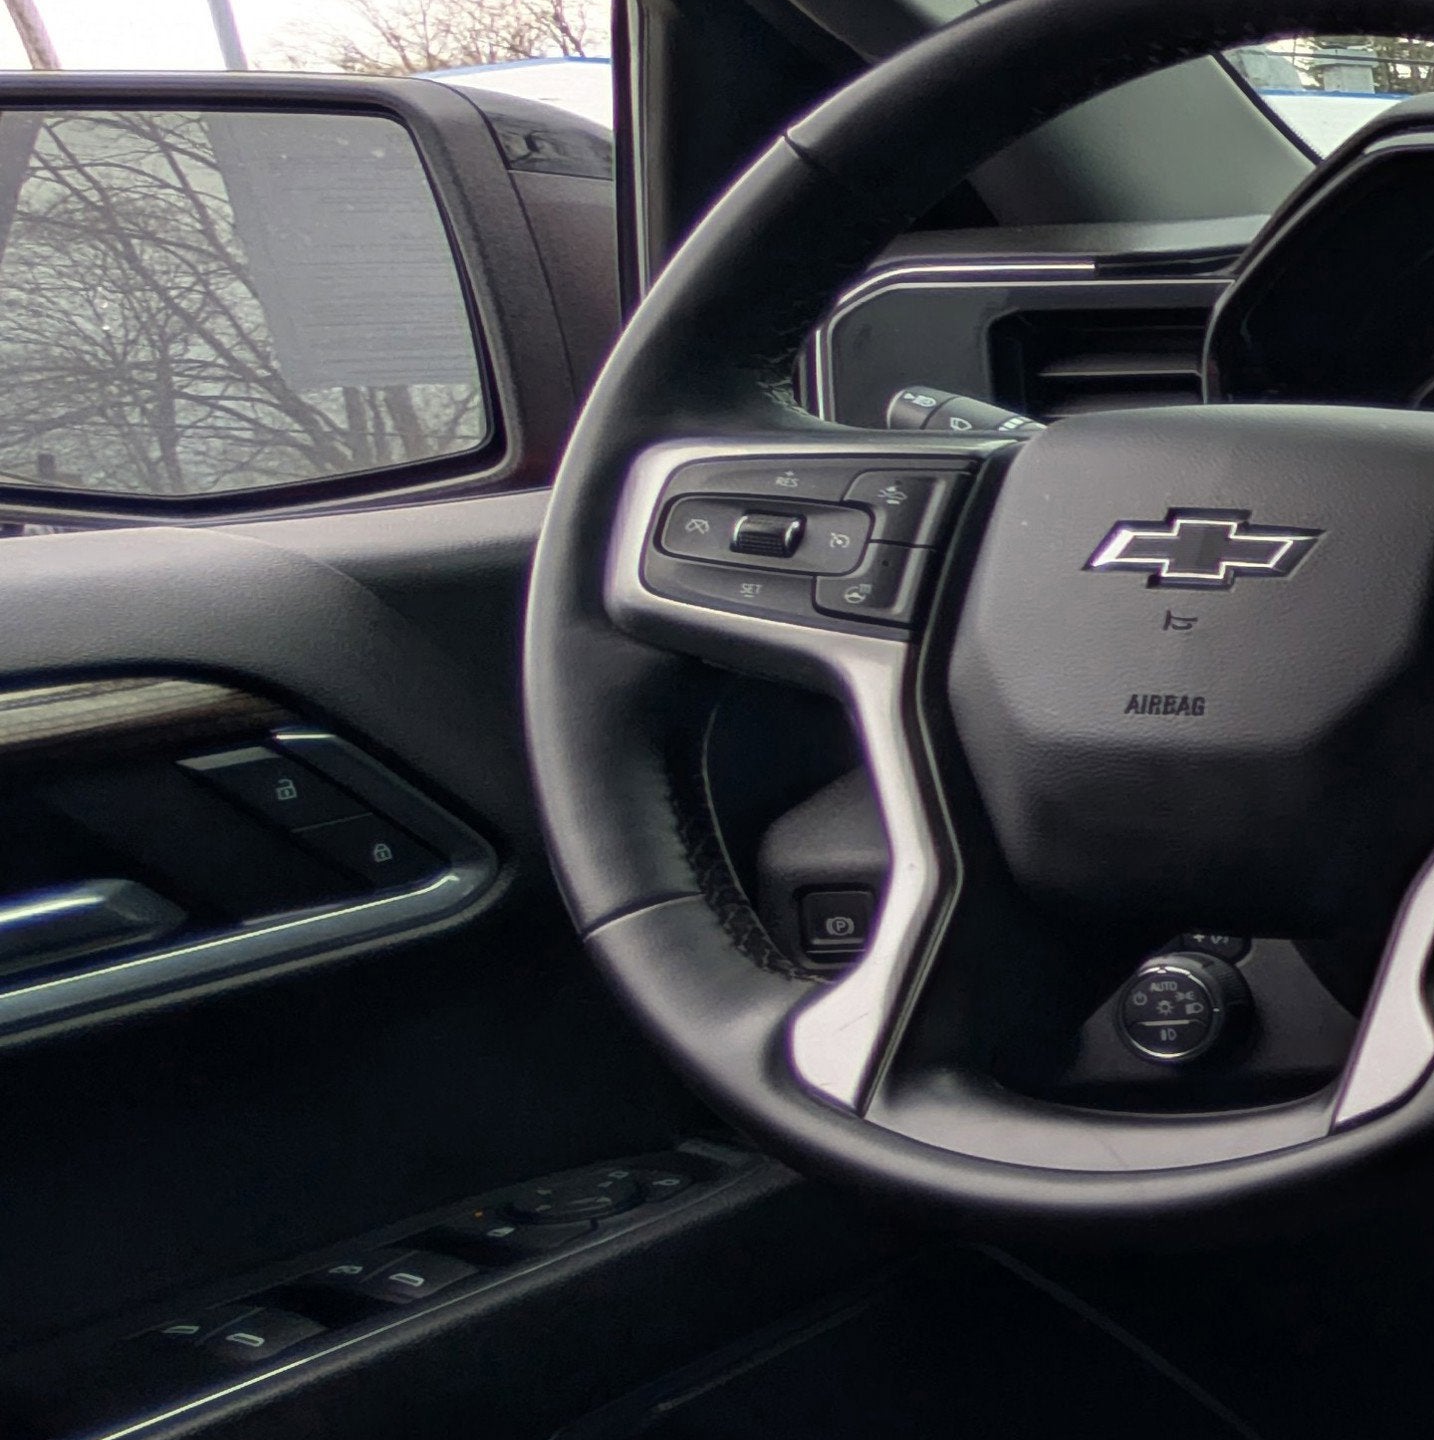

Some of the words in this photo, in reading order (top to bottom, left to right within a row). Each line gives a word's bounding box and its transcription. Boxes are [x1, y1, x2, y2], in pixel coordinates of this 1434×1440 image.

[775, 475, 800, 488] RES
[739, 582, 763, 596] SET
[1124, 692, 1207, 718] AIRBAG
[1149, 980, 1178, 993] AUTO
